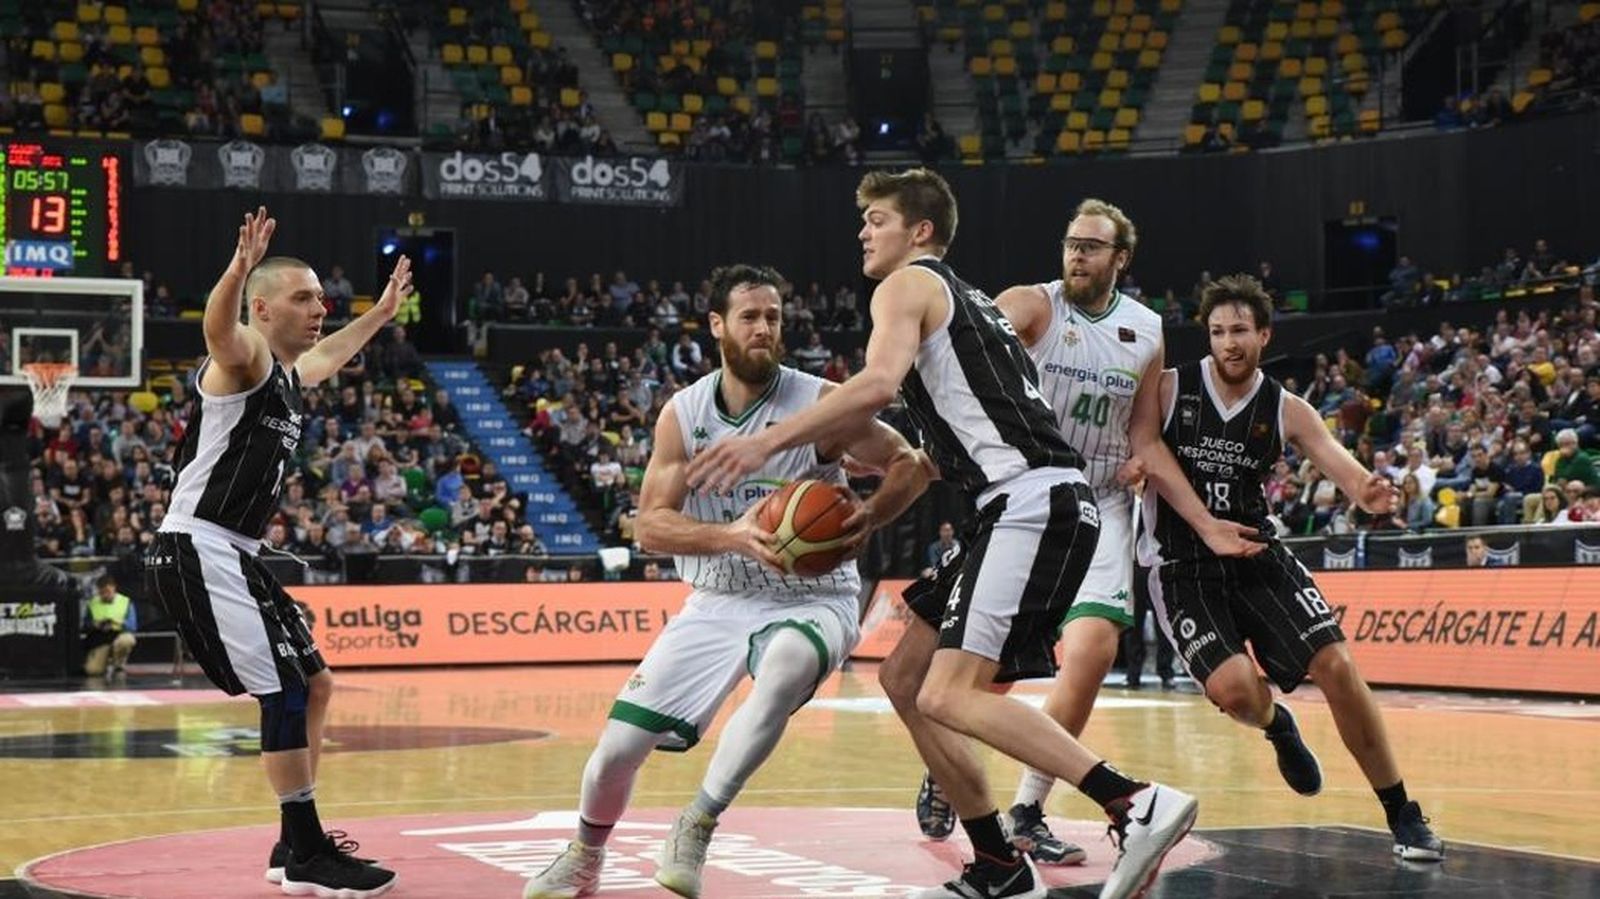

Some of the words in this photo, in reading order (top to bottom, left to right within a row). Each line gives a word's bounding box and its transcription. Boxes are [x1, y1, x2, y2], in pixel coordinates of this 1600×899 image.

[14, 170, 68, 190] 05:57
[440, 151, 542, 182] dos54
[571, 155, 670, 187] dos54
[31, 196, 66, 233] 13
[14, 245, 71, 266] IMQ
[1045, 361, 1098, 383] energia
[1105, 374, 1135, 391] plus
[1071, 393, 1111, 427] 40
[1200, 436, 1245, 453] JUEGO
[1205, 481, 1231, 511] 18
[325, 604, 421, 631] LaLiga
[1294, 587, 1331, 618] 18
[449, 605, 650, 637] DESCÁRGATE
[1354, 601, 1527, 646] DESCÁRGATE
[1528, 611, 1567, 647] LA
